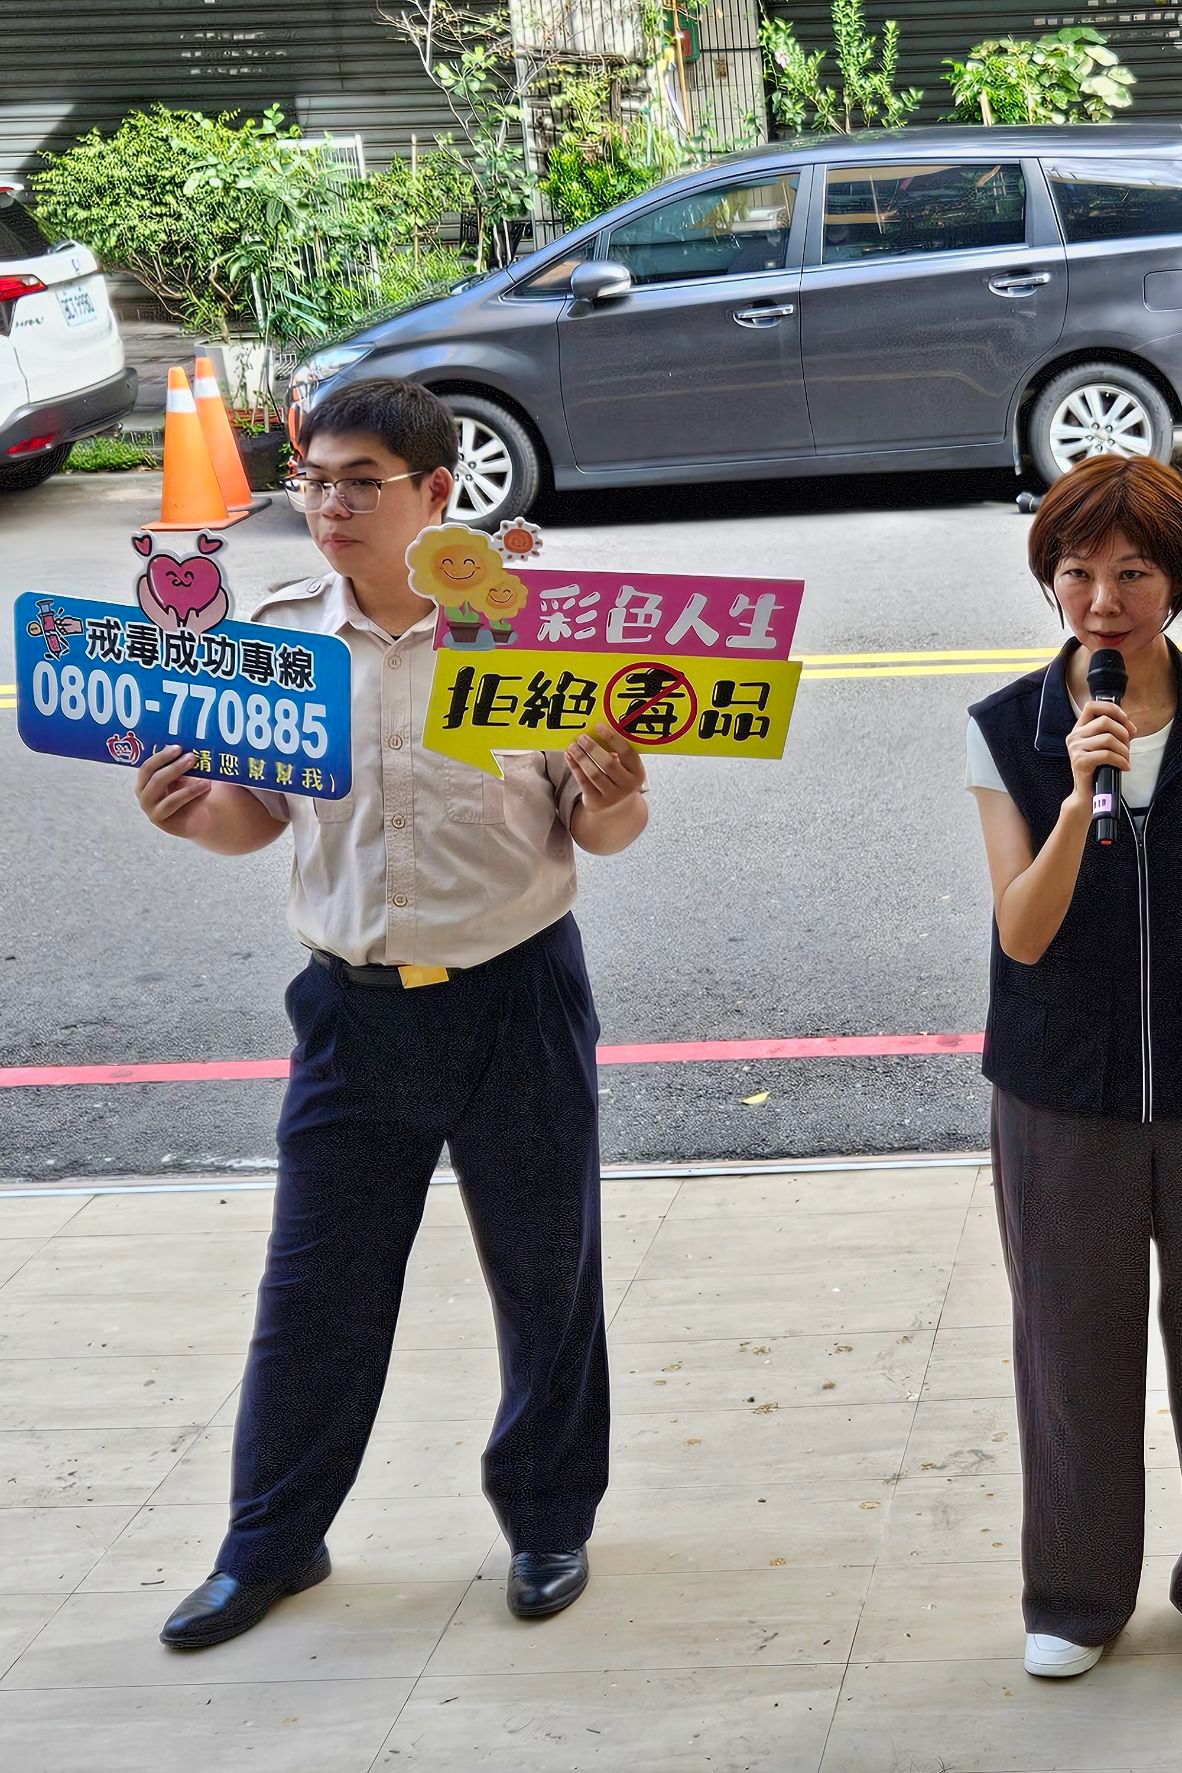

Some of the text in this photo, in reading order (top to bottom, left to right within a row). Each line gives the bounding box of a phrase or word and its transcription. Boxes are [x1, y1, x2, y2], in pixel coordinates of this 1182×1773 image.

[537, 583, 785, 649] 彩色人生
[86, 617, 314, 690] 戒毒成功專線
[32, 660, 328, 760] 0800-770885
